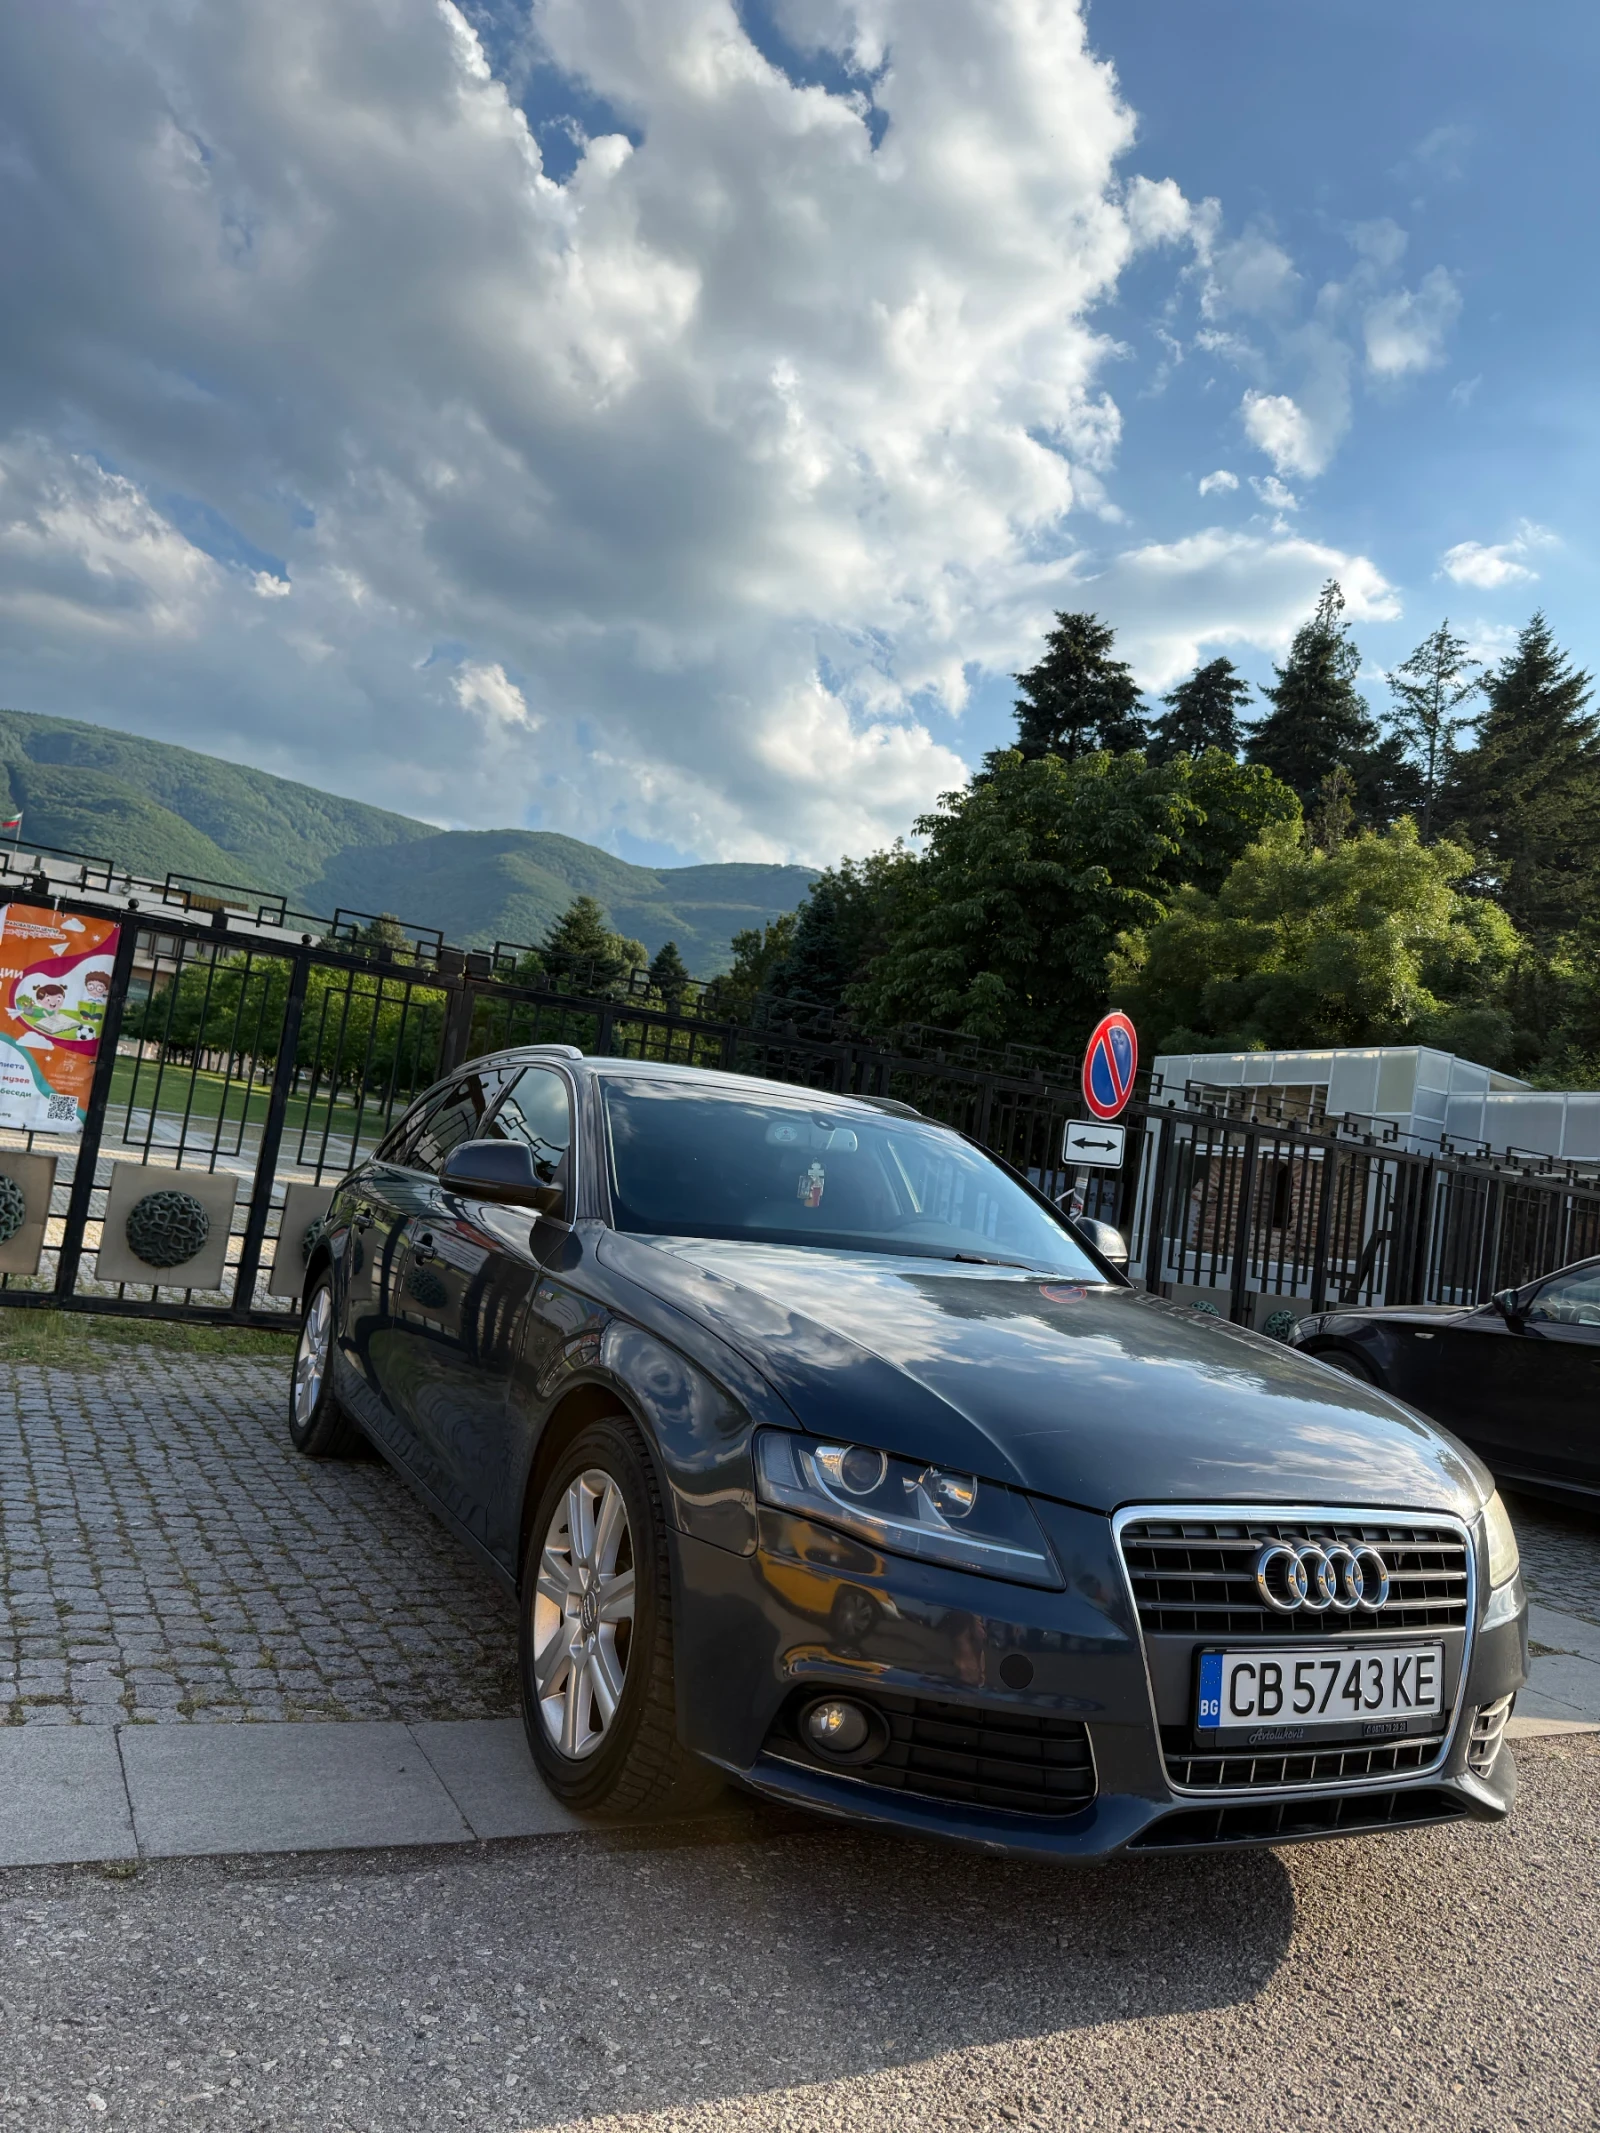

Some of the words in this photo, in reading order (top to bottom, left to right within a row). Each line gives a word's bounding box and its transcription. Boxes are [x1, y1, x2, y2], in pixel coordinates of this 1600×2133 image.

[2, 1076, 30, 1084] музея
[0, 1087, 32, 1098] беседи
[1200, 1699, 1219, 1716] BG
